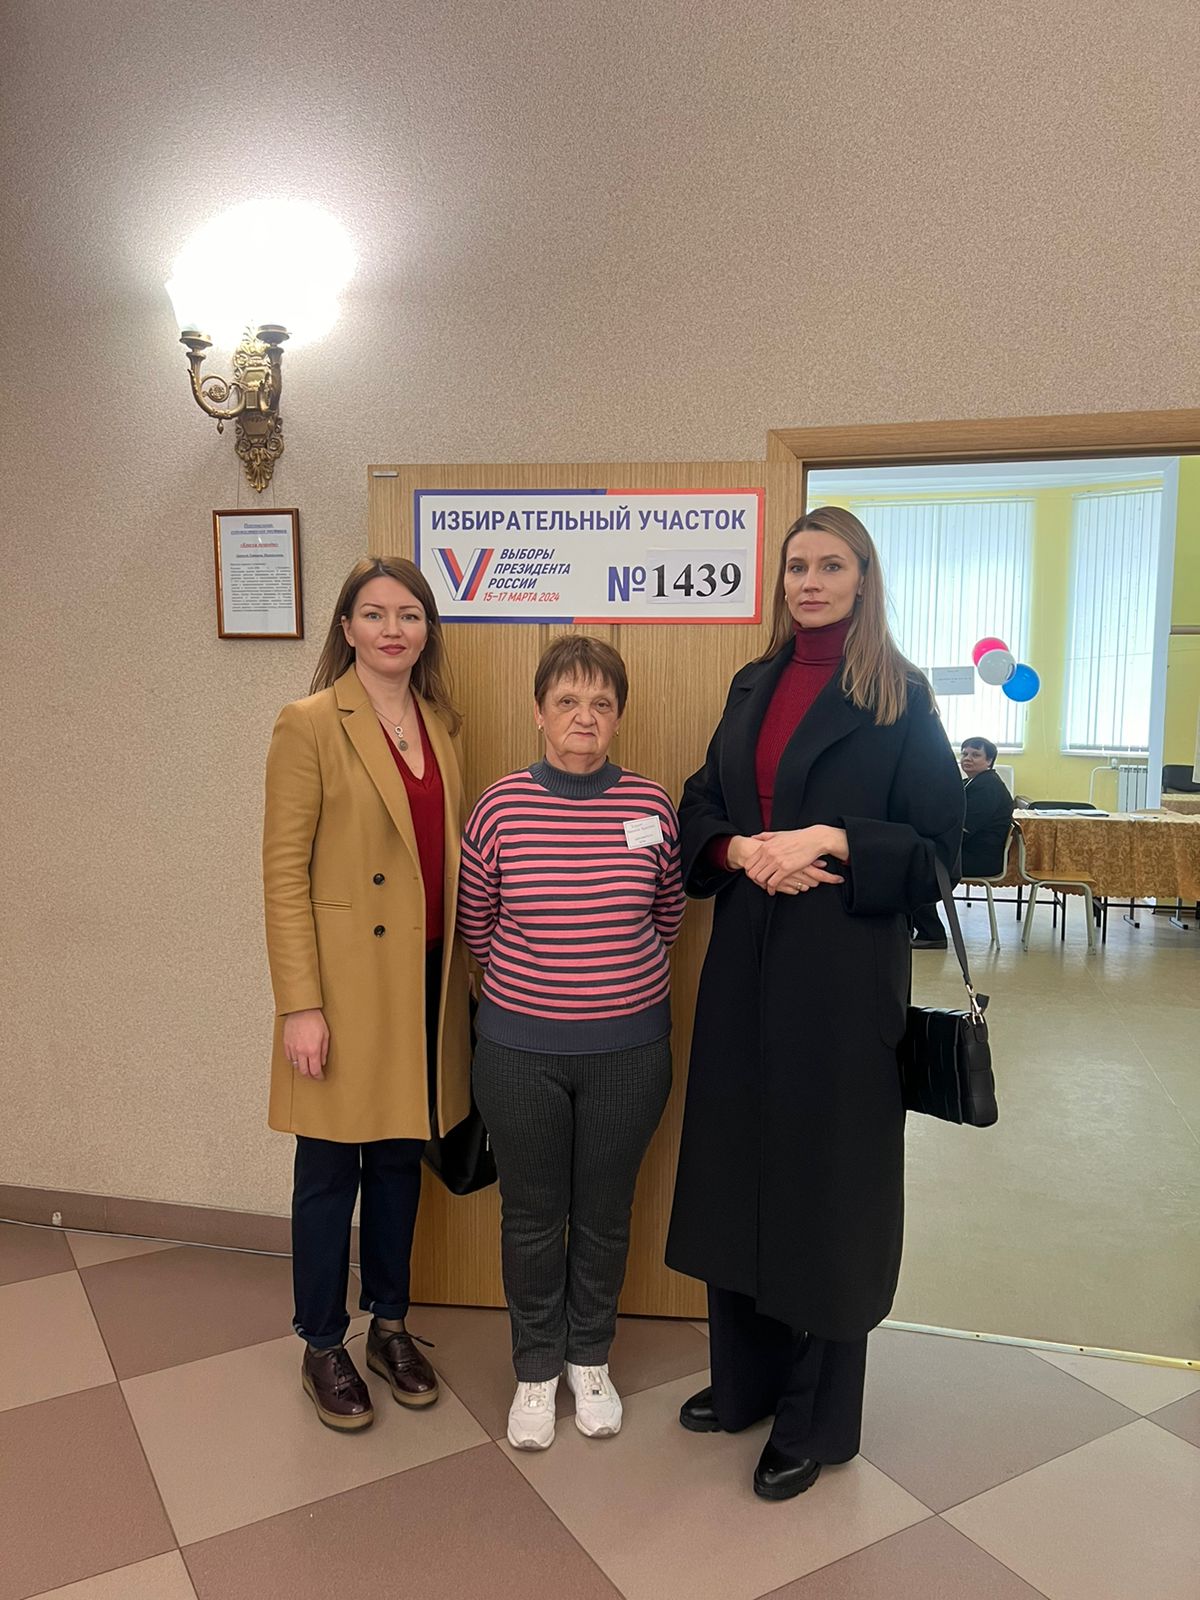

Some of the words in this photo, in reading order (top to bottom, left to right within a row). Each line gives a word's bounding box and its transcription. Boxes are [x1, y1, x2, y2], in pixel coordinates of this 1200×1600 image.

[432, 505, 631, 531] ИЗБИРАТЕЛЬНЫЙ
[638, 509, 746, 531] УЧАСТОК
[500, 548, 555, 560] ВЫБОРЫ
[494, 563, 571, 576] ПРЕЗИДЕНТА
[488, 578, 538, 589] РОССИИ
[507, 592, 538, 602] МАРТА
[538, 592, 560, 602] 2024
